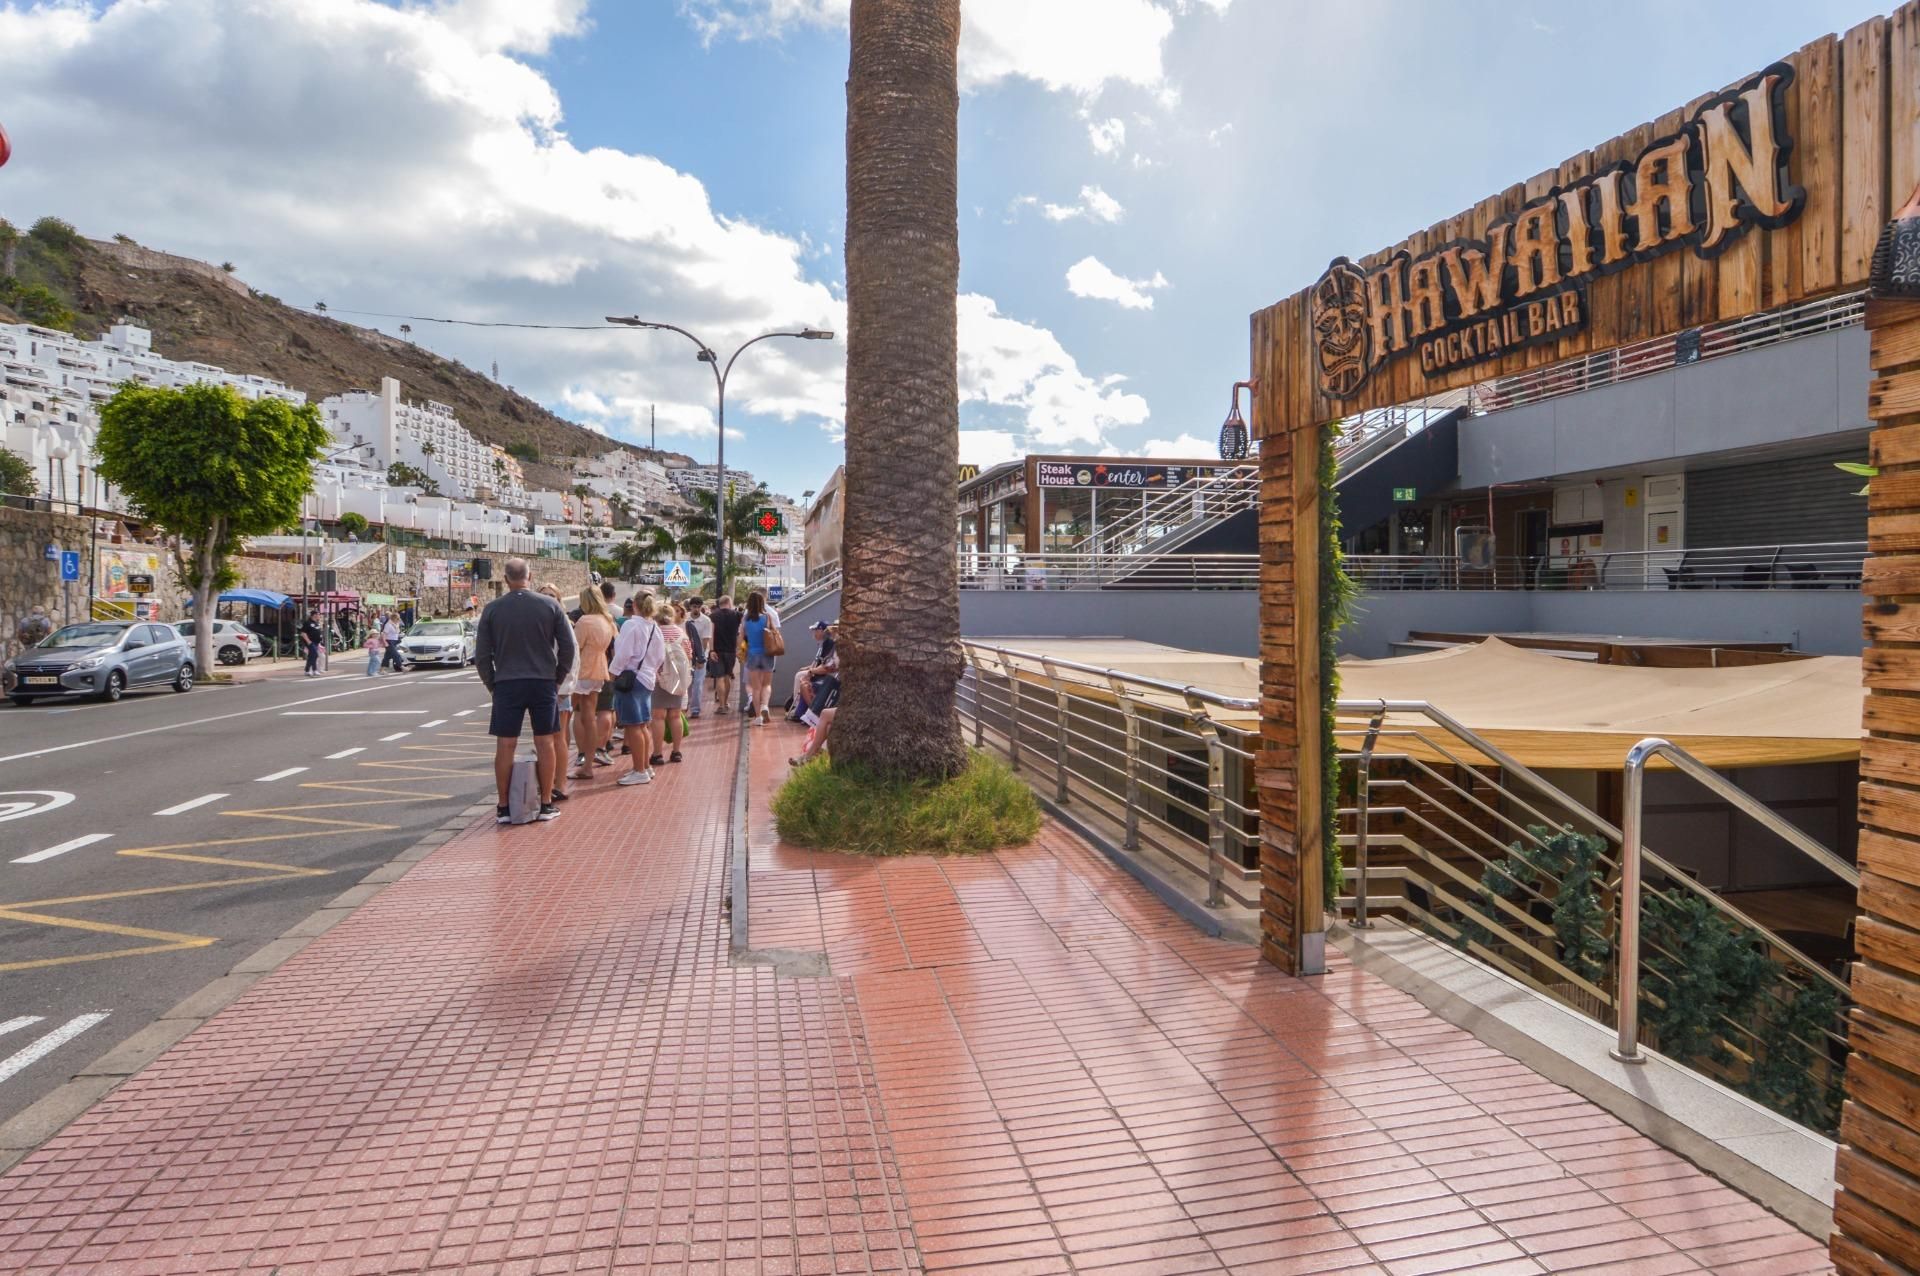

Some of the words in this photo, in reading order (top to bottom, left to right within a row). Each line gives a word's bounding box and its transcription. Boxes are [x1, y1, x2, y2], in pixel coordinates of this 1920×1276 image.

[1364, 72, 1795, 365] HAWAIIAN
[1422, 310, 1526, 372] COCKTAIL
[1528, 291, 1580, 336] BAR
[1040, 464, 1072, 475] Steak
[1041, 475, 1075, 485] House
